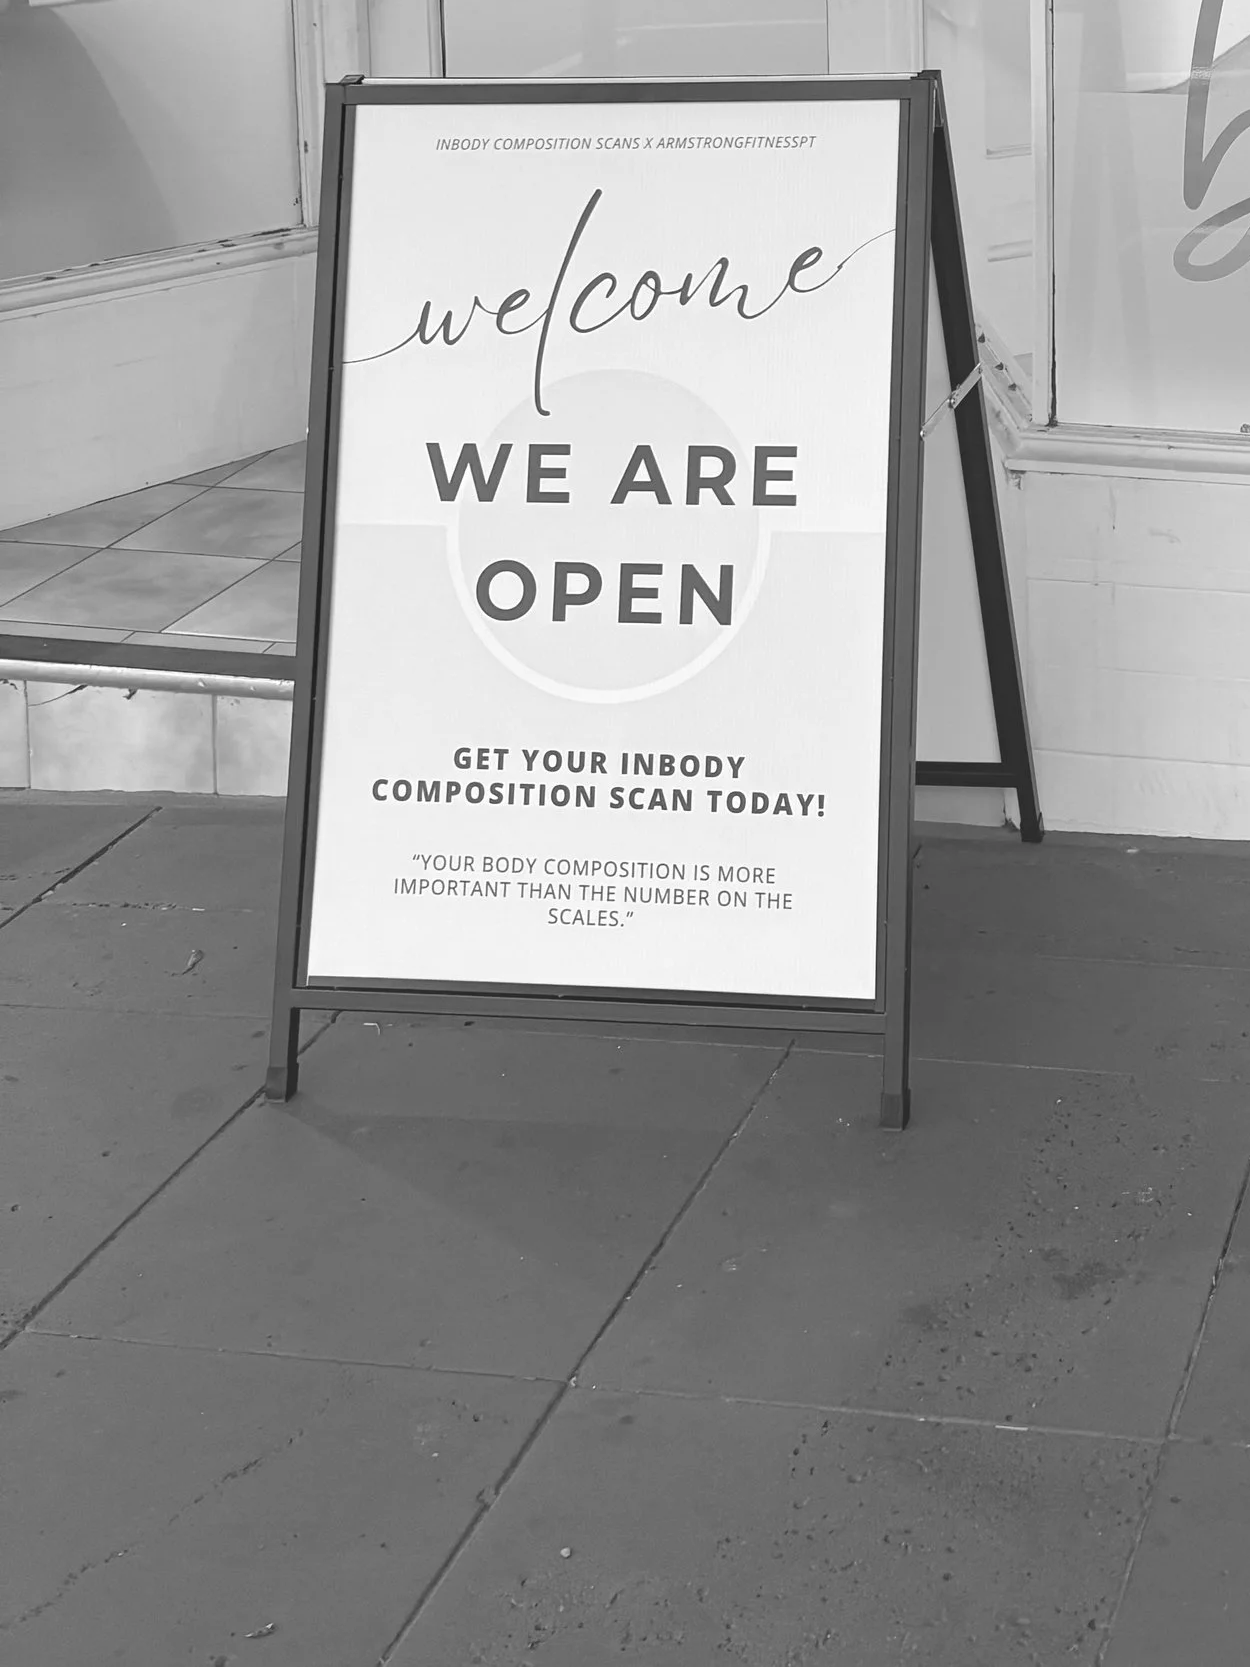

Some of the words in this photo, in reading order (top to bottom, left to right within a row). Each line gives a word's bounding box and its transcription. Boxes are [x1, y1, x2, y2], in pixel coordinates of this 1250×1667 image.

[436, 138, 489, 151] INBODY
[493, 137, 592, 151] COMPOSITION
[595, 137, 640, 150] SCANS
[643, 137, 654, 149] X
[656, 135, 817, 150] ARMSTRONGFITNESSPT
[343, 188, 896, 417] welcome
[426, 443, 572, 503] WE
[610, 444, 798, 507] ARE
[476, 559, 735, 626] OPEN
[453, 746, 510, 771] GET
[521, 749, 608, 774] YOUR
[621, 752, 746, 779] INBODY
[371, 778, 597, 808] COMPOSITION
[609, 786, 693, 812] SCAN
[706, 789, 826, 817] TODAY!
[482, 856, 538, 875] BODY
[544, 858, 686, 881] COMPOSITION
[693, 864, 711, 882] IS
[717, 866, 776, 885] MORE
[393, 877, 511, 899] IMPORTANT
[517, 882, 572, 901] THAN
[579, 884, 617, 903] THE
[624, 886, 710, 907] NUMBER
[717, 889, 748, 908] ON
[754, 892, 793, 910] THE
